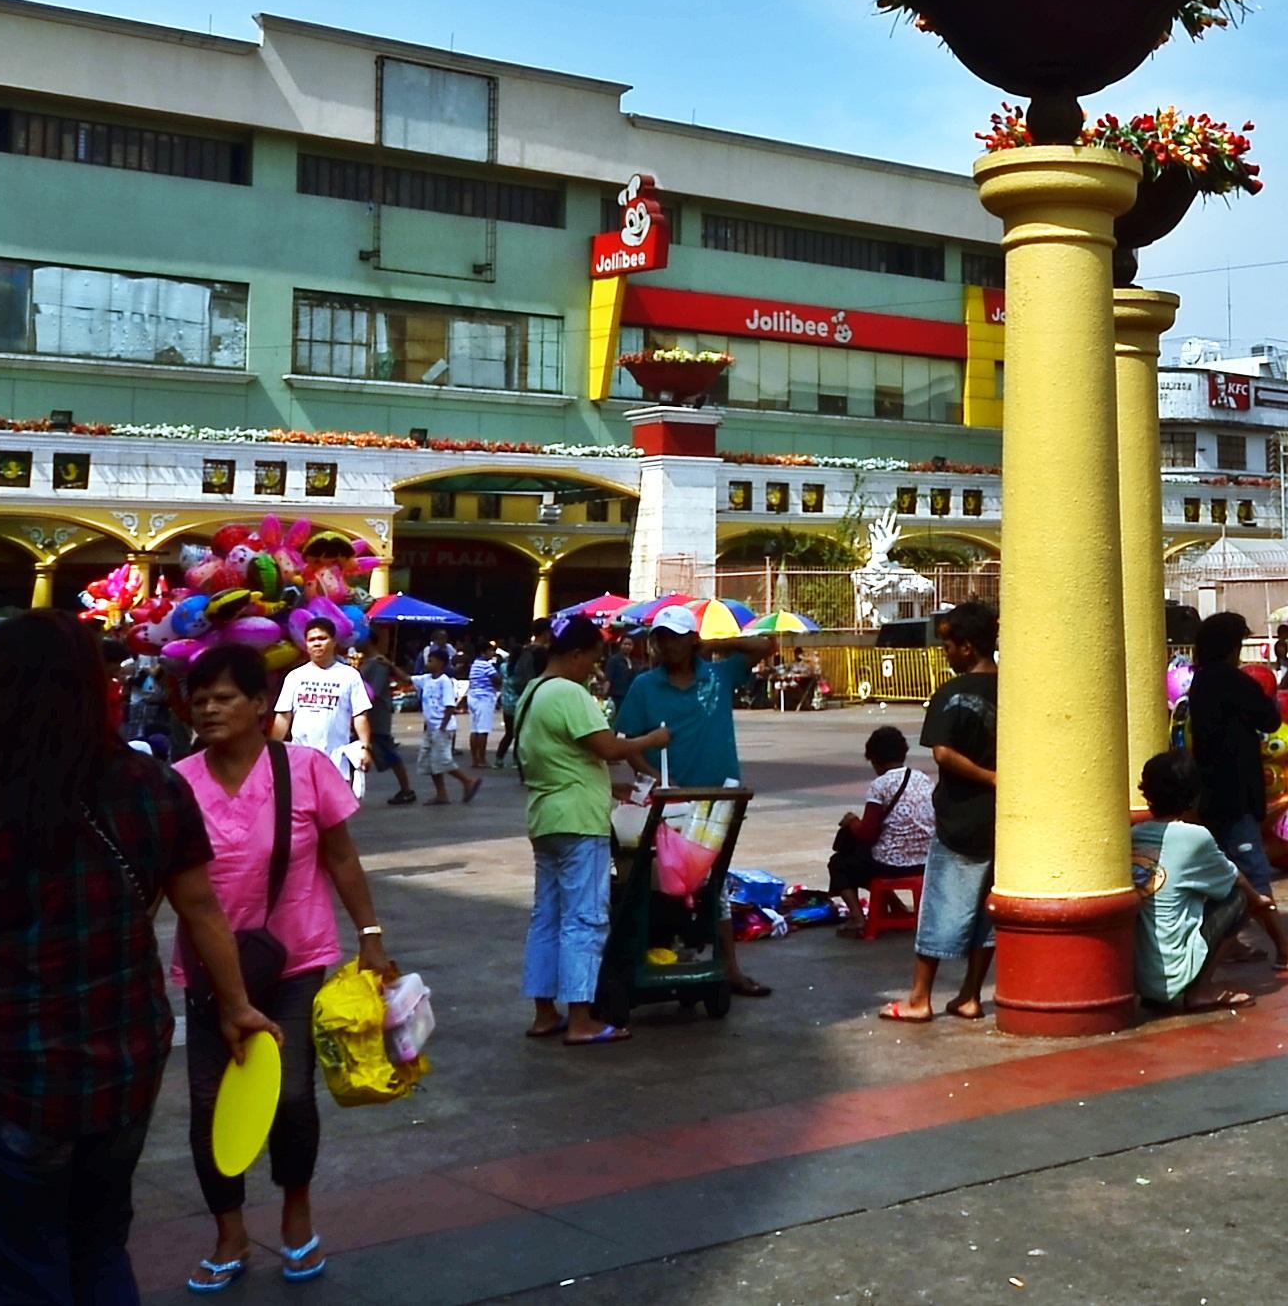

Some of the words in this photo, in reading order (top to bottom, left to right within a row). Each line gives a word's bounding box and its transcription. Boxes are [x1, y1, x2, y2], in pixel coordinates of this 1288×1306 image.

[596, 250, 646, 273] Jollibee
[746, 309, 828, 337] Jollibee
[1227, 382, 1248, 396] KFC
[438, 550, 497, 566] PLAZA
